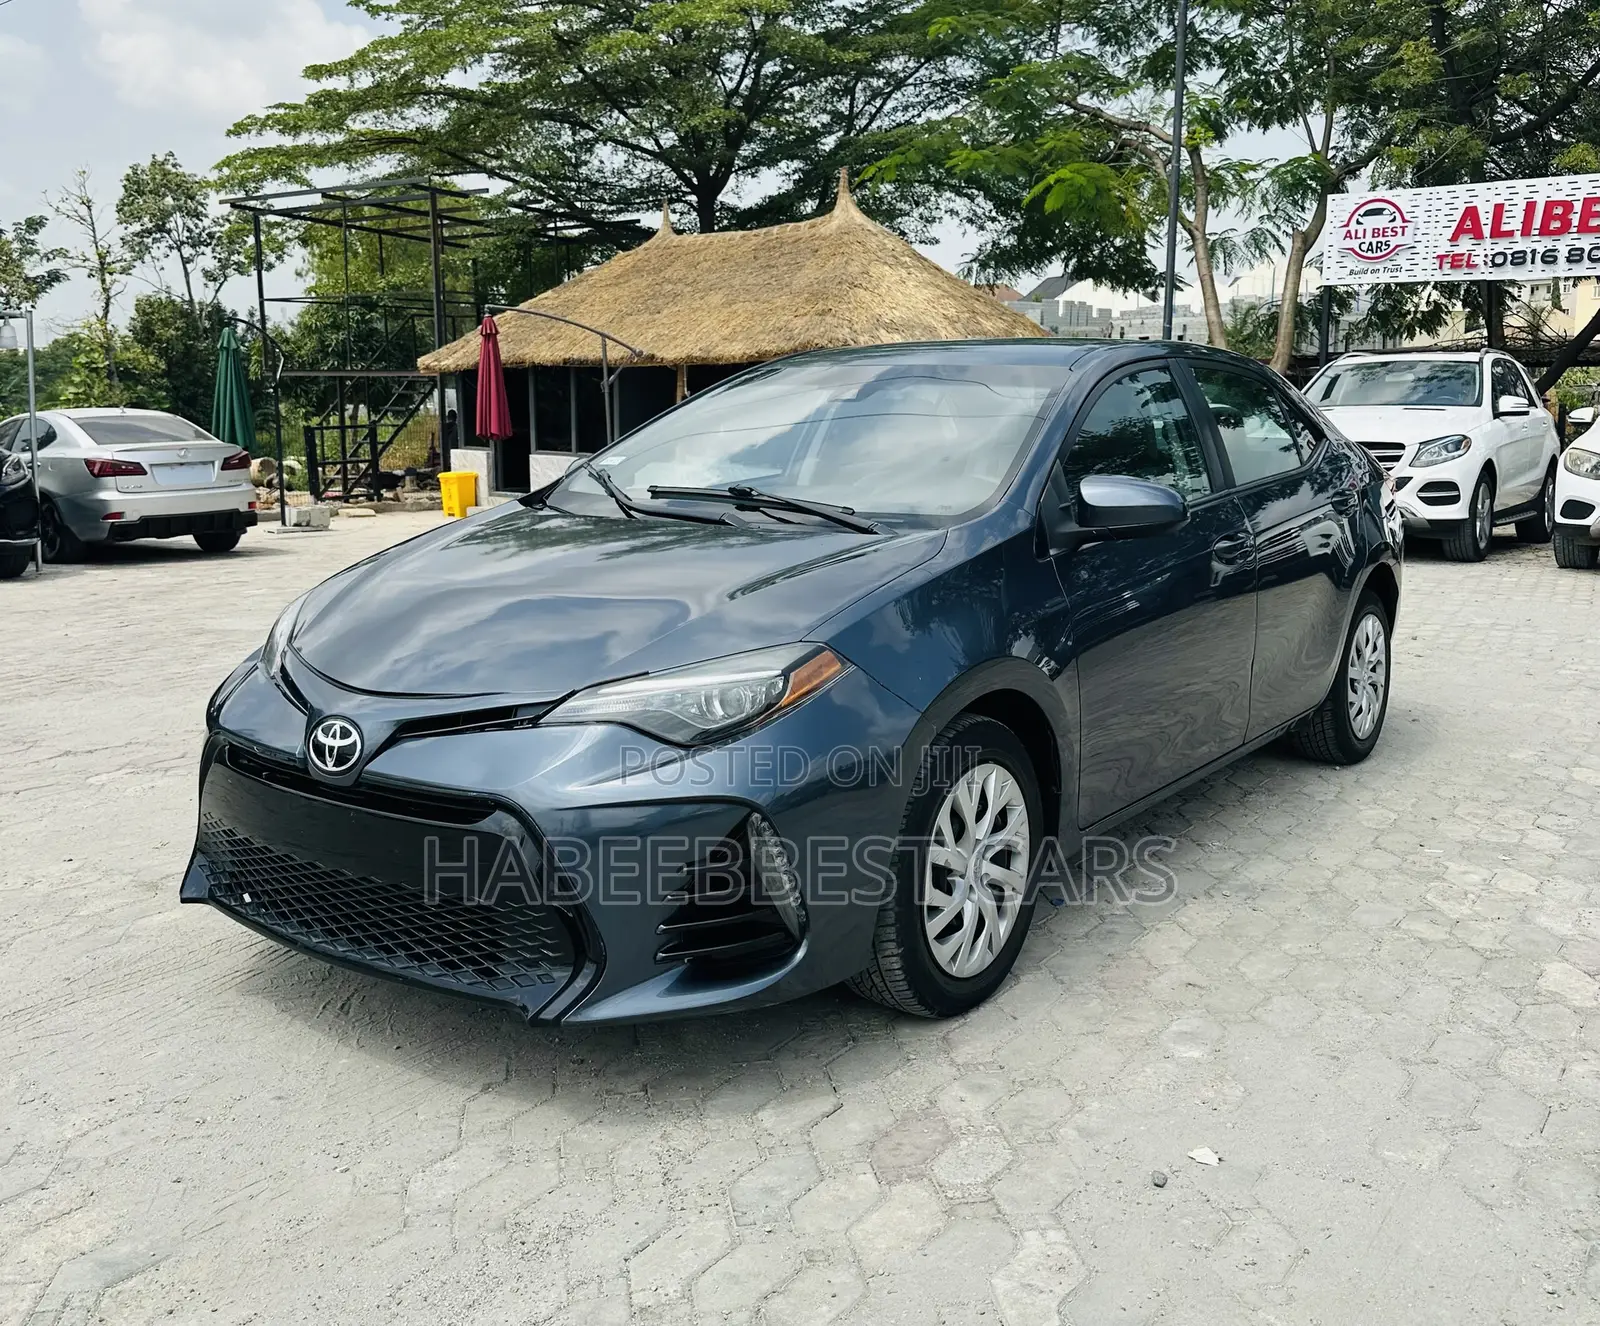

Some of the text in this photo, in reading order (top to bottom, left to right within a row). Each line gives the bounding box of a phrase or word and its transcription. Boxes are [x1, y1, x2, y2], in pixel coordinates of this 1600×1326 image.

[1450, 197, 1600, 241] ALIBE
[1343, 226, 1408, 240] ALI BEST
[1359, 240, 1391, 254] CARS
[1490, 248, 1559, 268] 0816
[1348, 267, 1369, 276] Build
[1383, 266, 1403, 274] Trust
